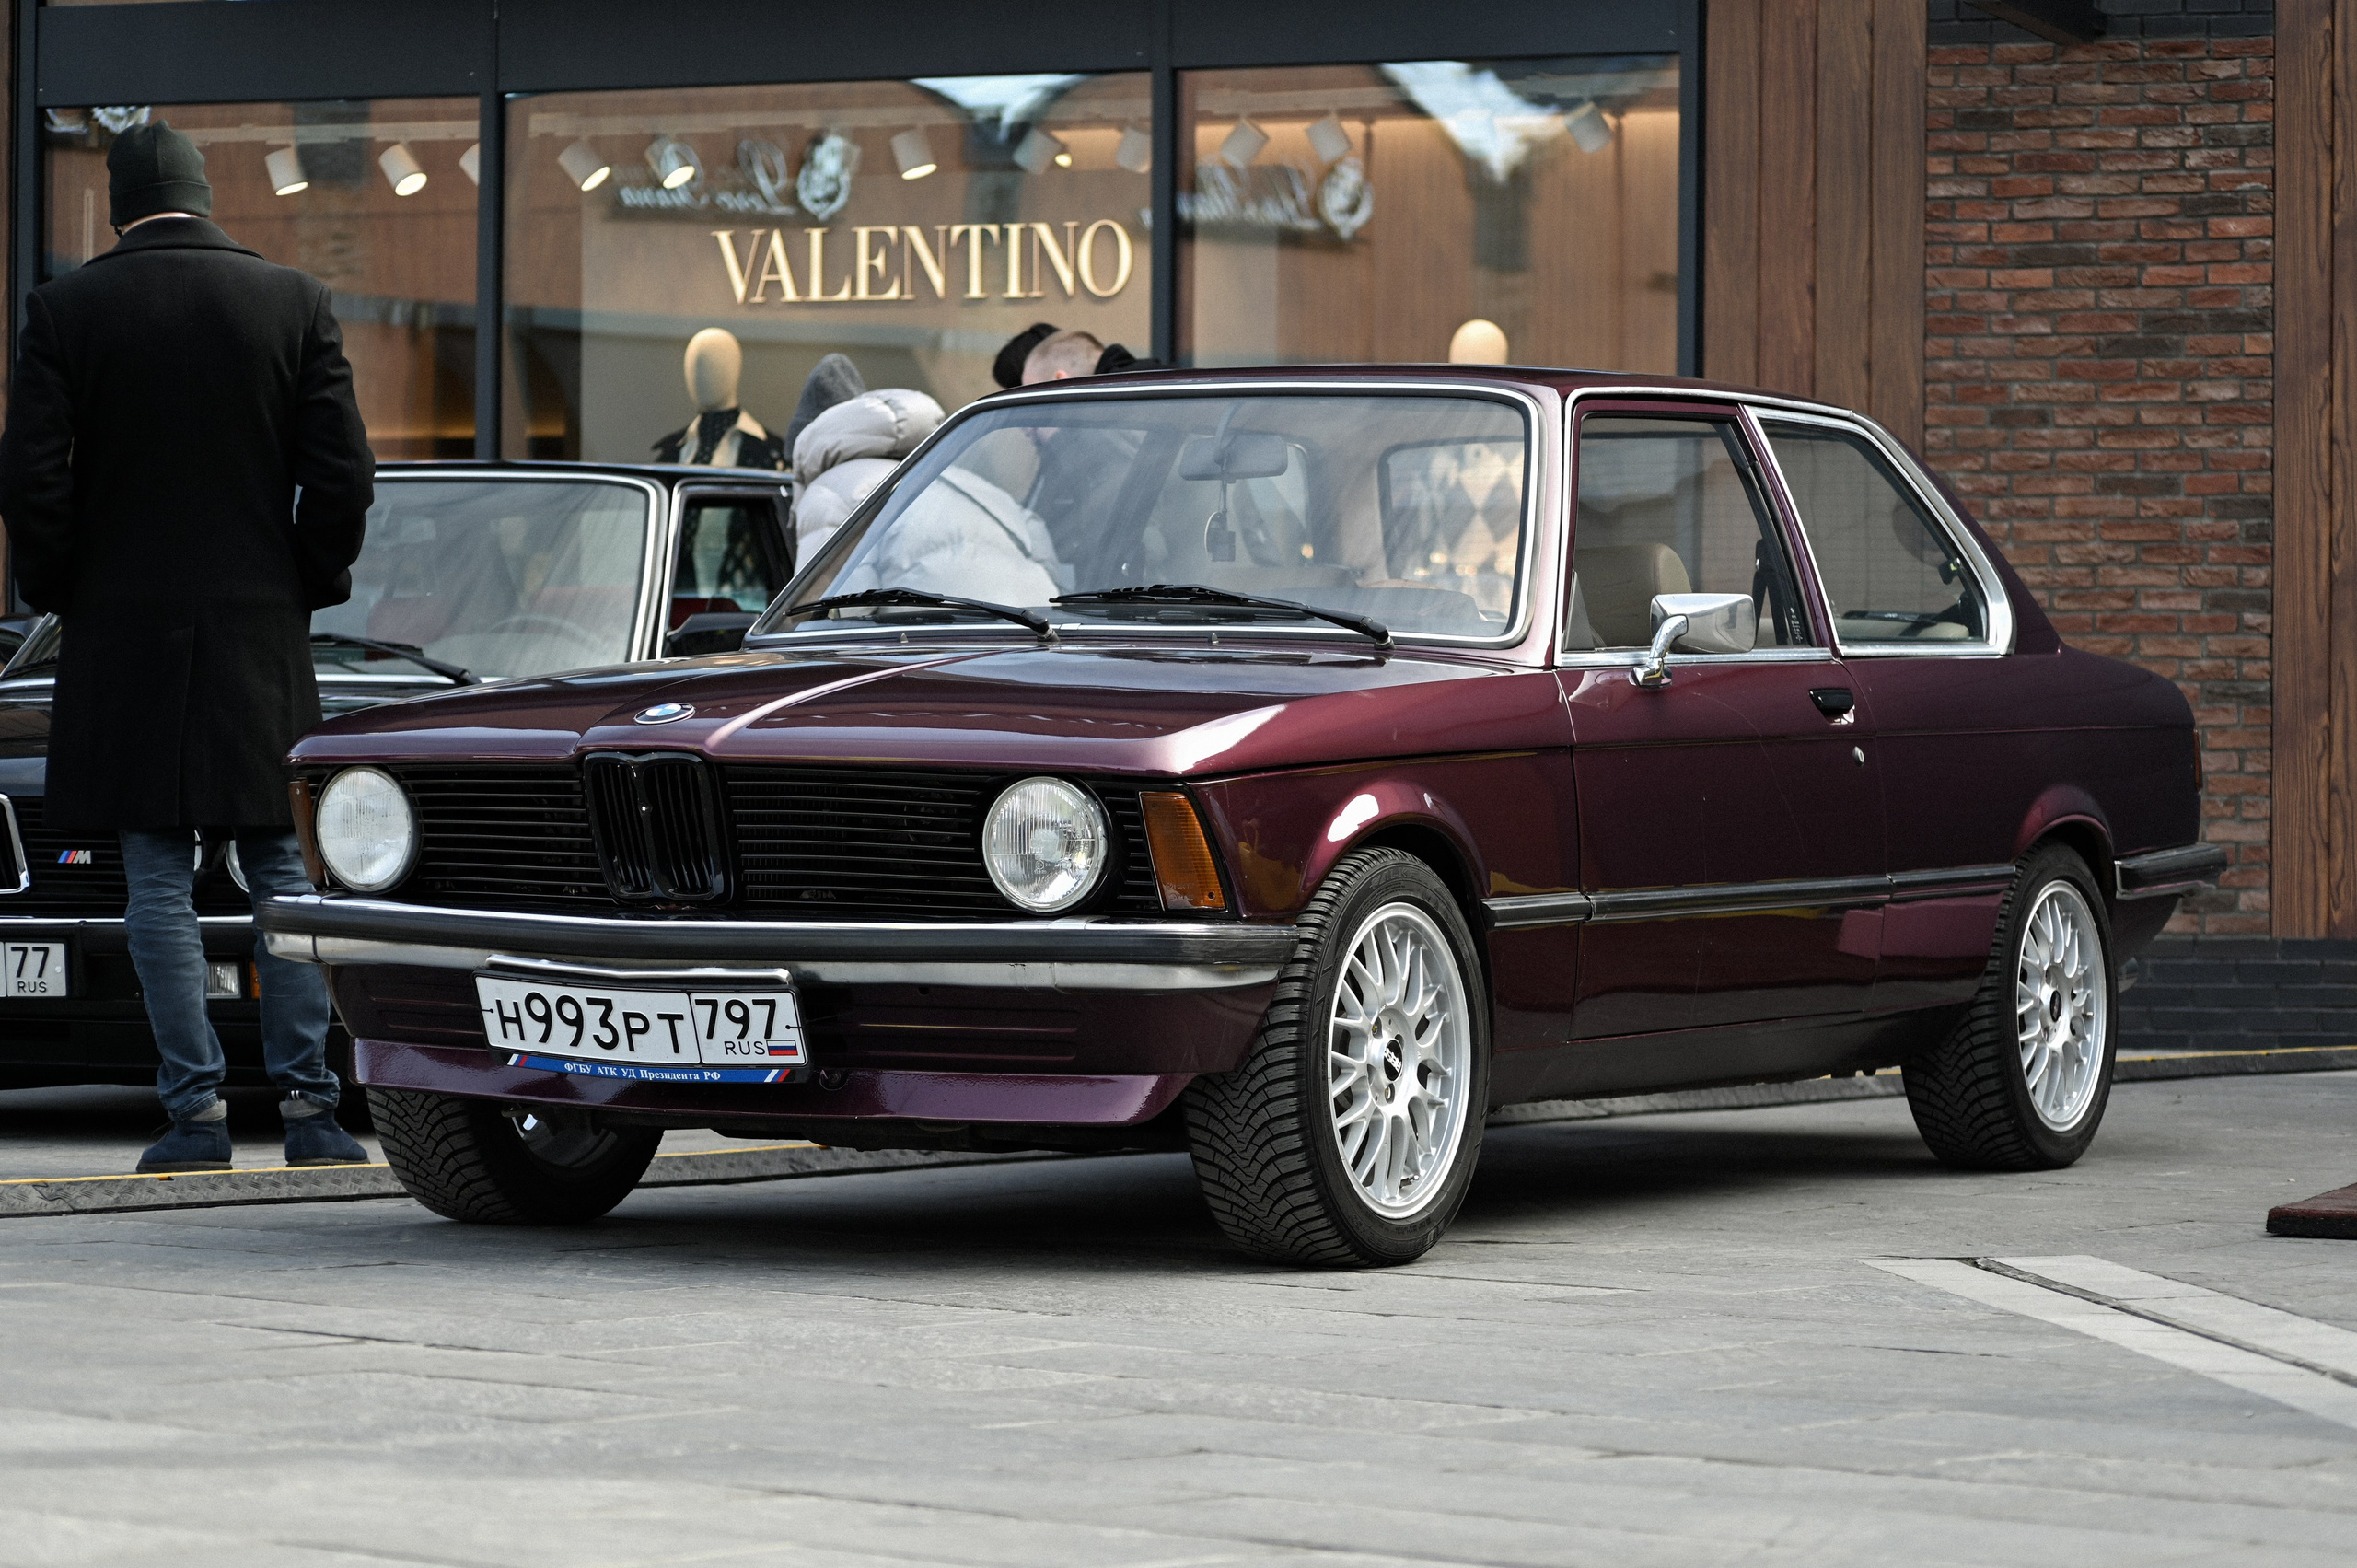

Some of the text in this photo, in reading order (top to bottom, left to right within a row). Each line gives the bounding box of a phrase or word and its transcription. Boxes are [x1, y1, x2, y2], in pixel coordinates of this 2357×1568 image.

[710, 218, 1133, 305] VALENTINO
[10, 946, 50, 979] 77
[17, 981, 48, 993] RUS
[694, 998, 777, 1040] 797
[724, 1040, 766, 1056] RUS
[563, 1063, 721, 1081] ФГБУ АТК УД Президента РФ
